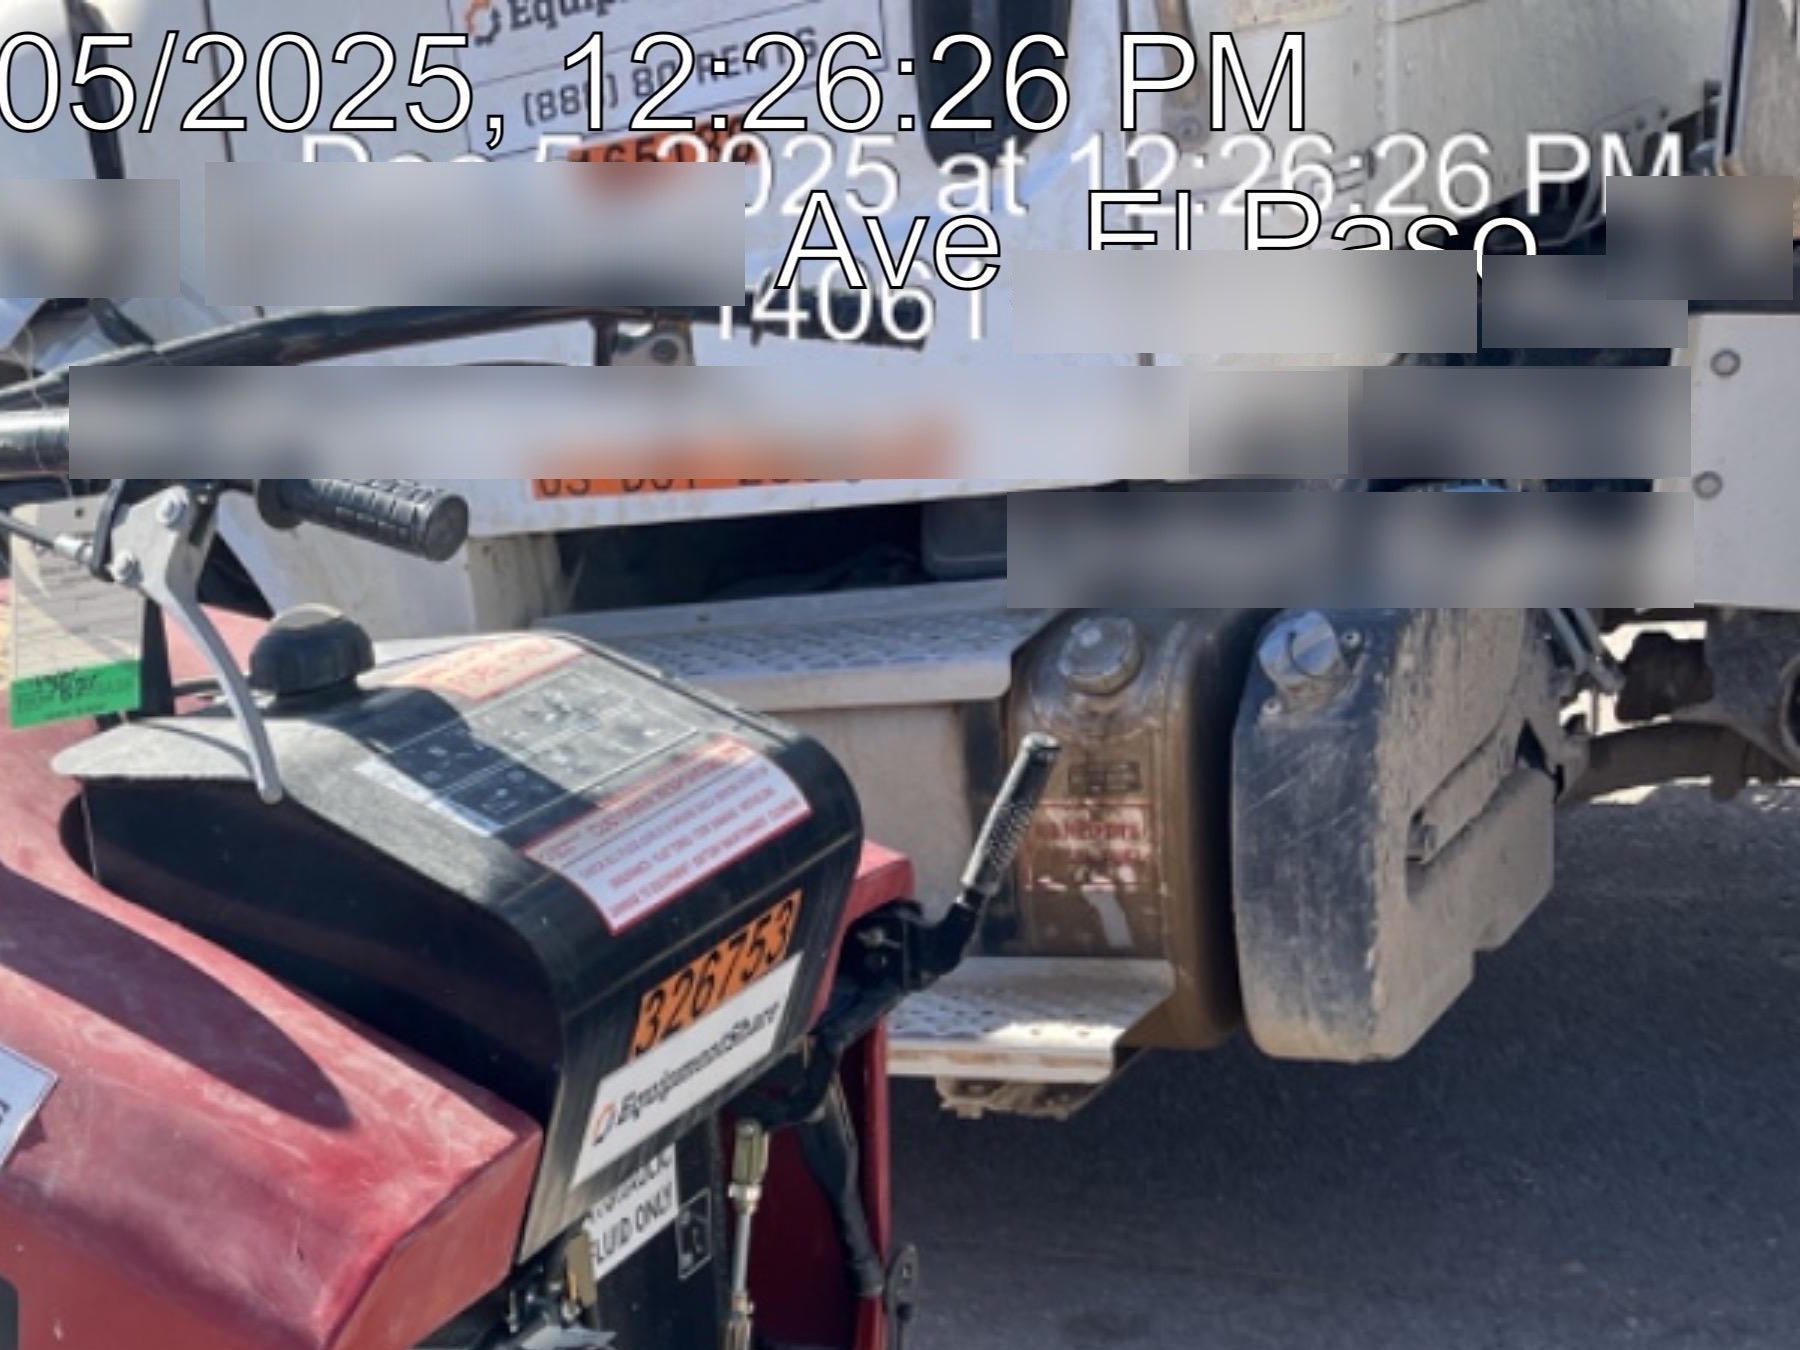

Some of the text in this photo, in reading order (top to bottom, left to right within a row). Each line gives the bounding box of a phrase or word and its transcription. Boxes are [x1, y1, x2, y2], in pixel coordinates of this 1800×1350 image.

[523, 72, 618, 127] (88)
[633, 897, 796, 1058] 326753
[594, 1216, 634, 1266] LUID
